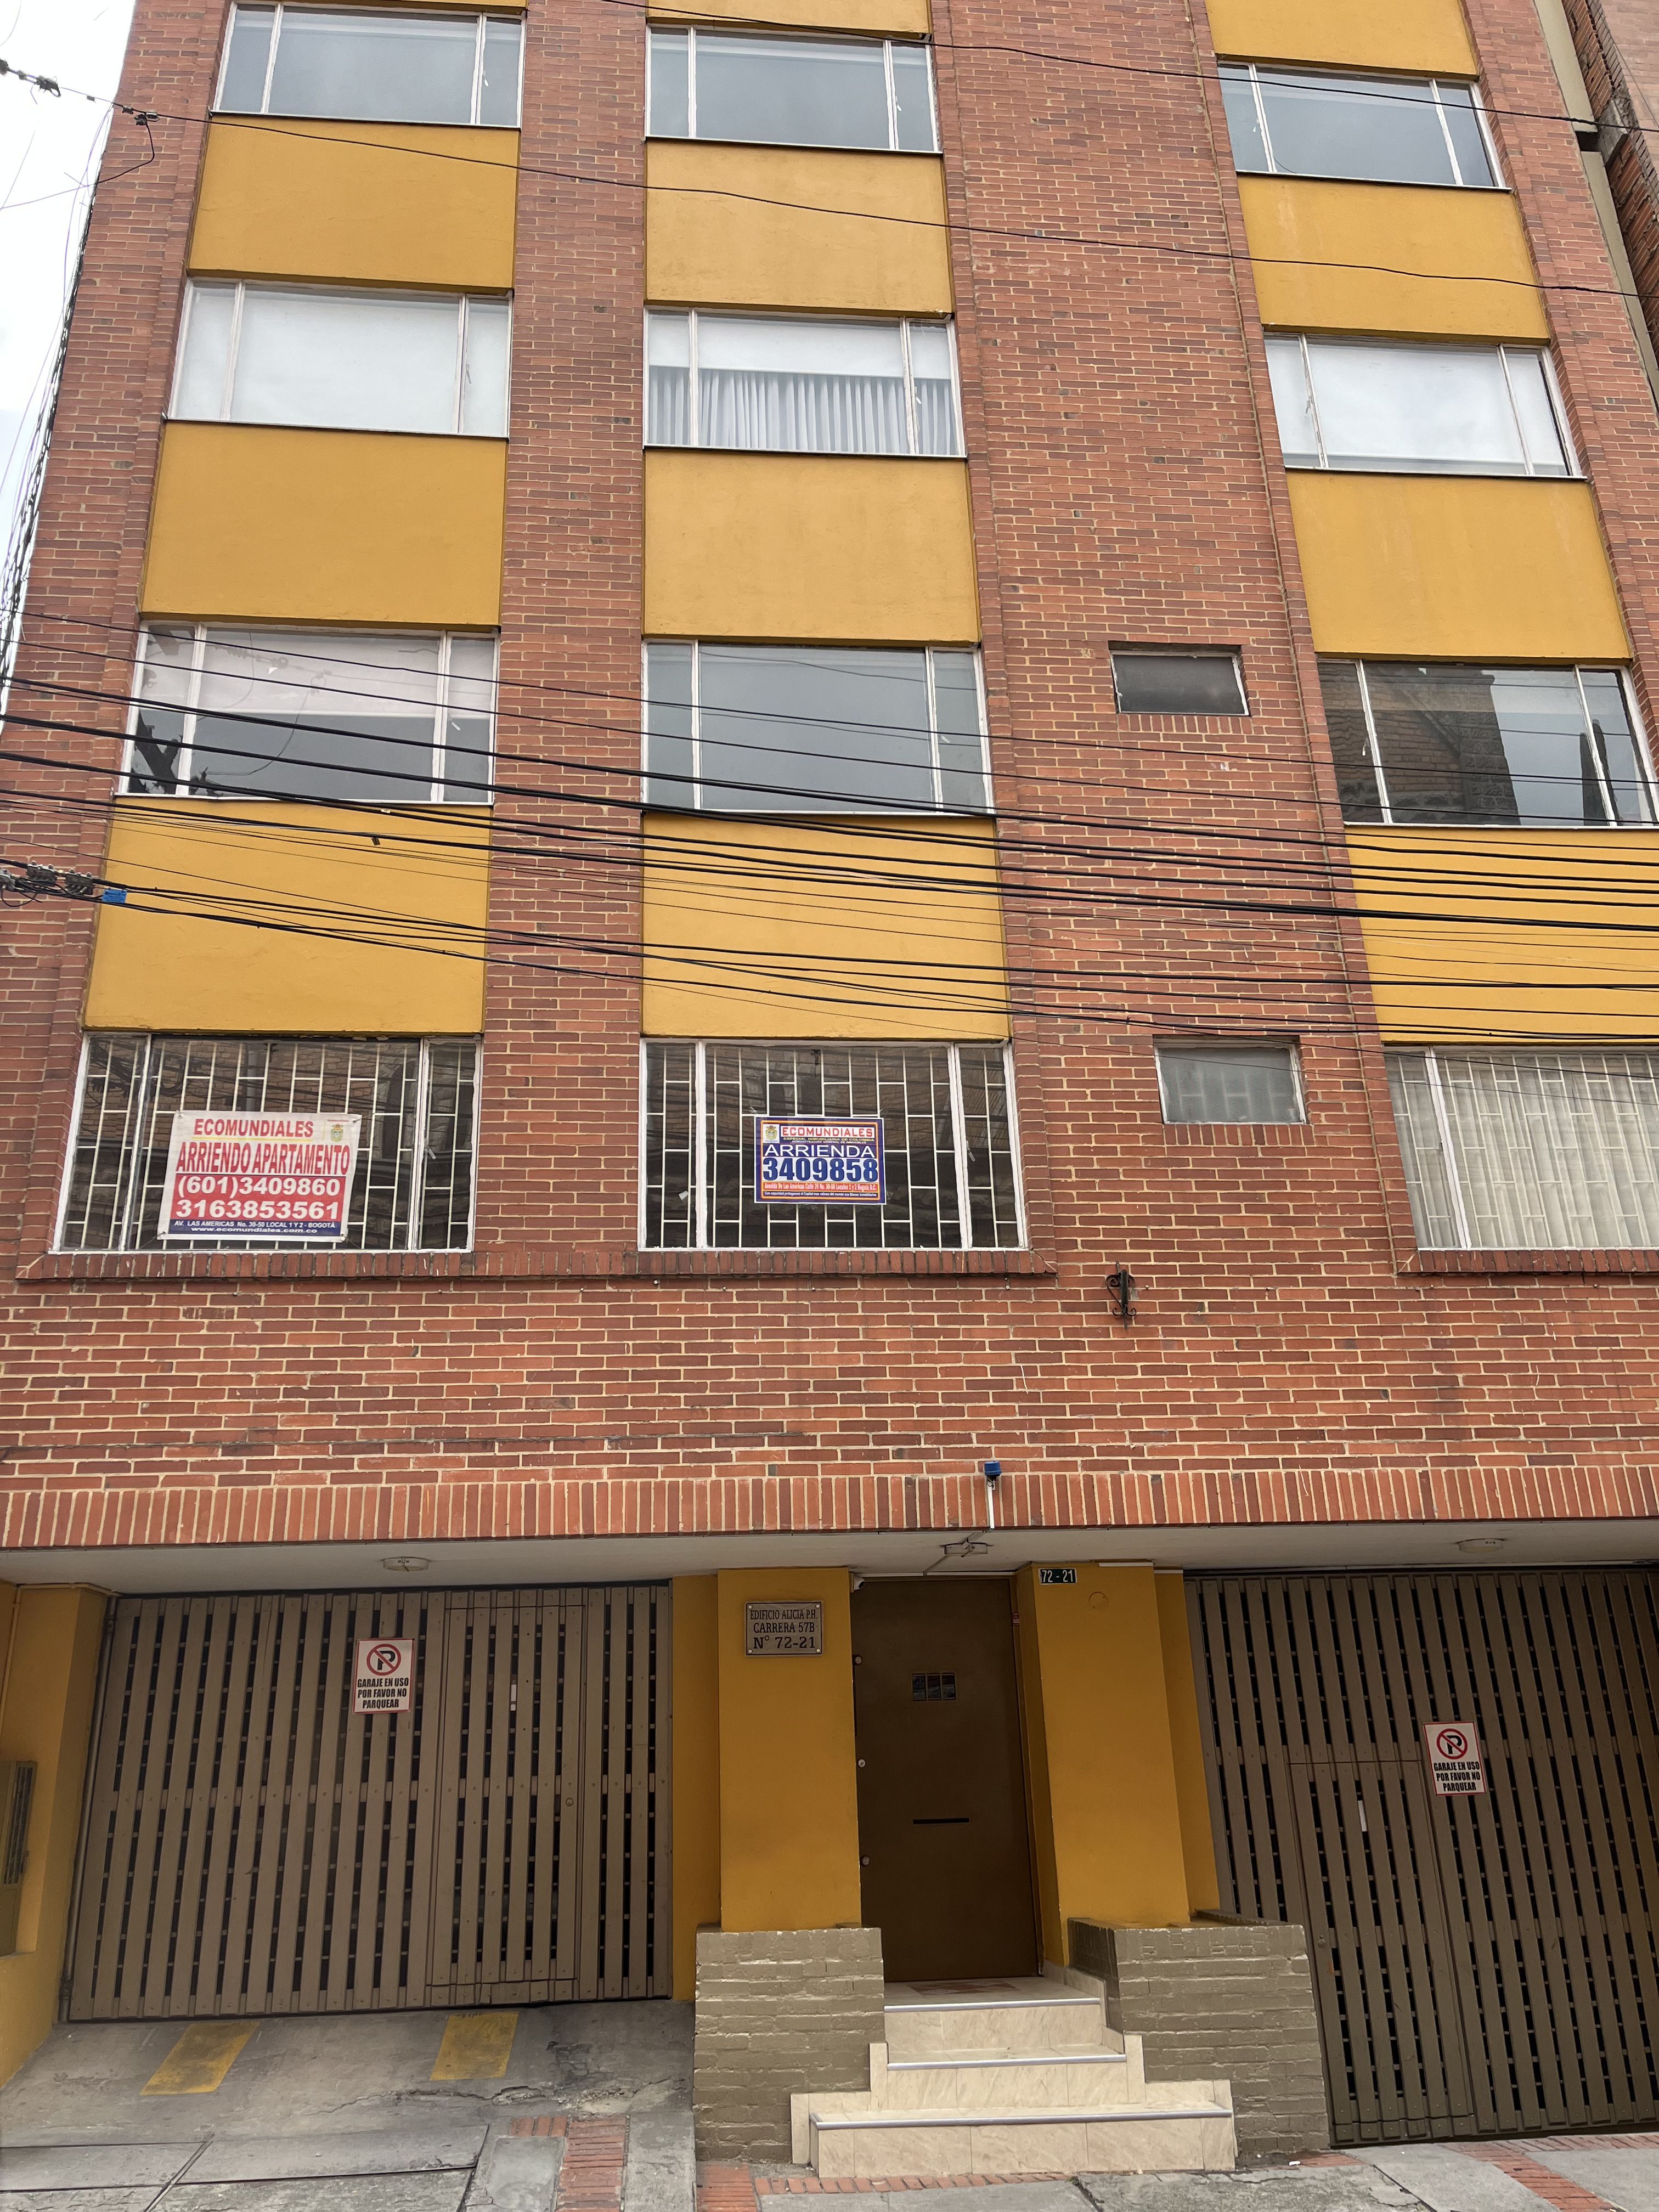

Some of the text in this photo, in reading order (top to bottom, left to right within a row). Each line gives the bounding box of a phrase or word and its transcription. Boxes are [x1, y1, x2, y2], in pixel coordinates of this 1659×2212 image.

[194, 1119, 314, 1137] ECOMUNDIALES
[783, 1127, 872, 1137] ECOMUNDIALES
[764, 1144, 876, 1158] ARRIENDA
[176, 1141, 351, 1175] ARRIENDO APARTAMENTO
[763, 1158, 878, 1182] 3409858
[178, 1176, 340, 1199] (601)3409860
[176, 1199, 339, 1220] 3163853561
[750, 1610, 780, 1620] EDIFICIO
[782, 1609, 804, 1620] ALICIA
[753, 1622, 815, 1633] CARRERA 57B
[775, 1637, 816, 1649] 72-21
[357, 1678, 409, 1688] GARAJE EN USO
[358, 1688, 407, 1699] POR FAVOR NO
[363, 1699, 399, 1709] PARQUEAR
[1434, 1761, 1480, 1771] GARAJE EN USO
[1436, 1771, 1481, 1781] POR FAVOR NO
[1443, 1782, 1476, 1792] PARQUEAR
